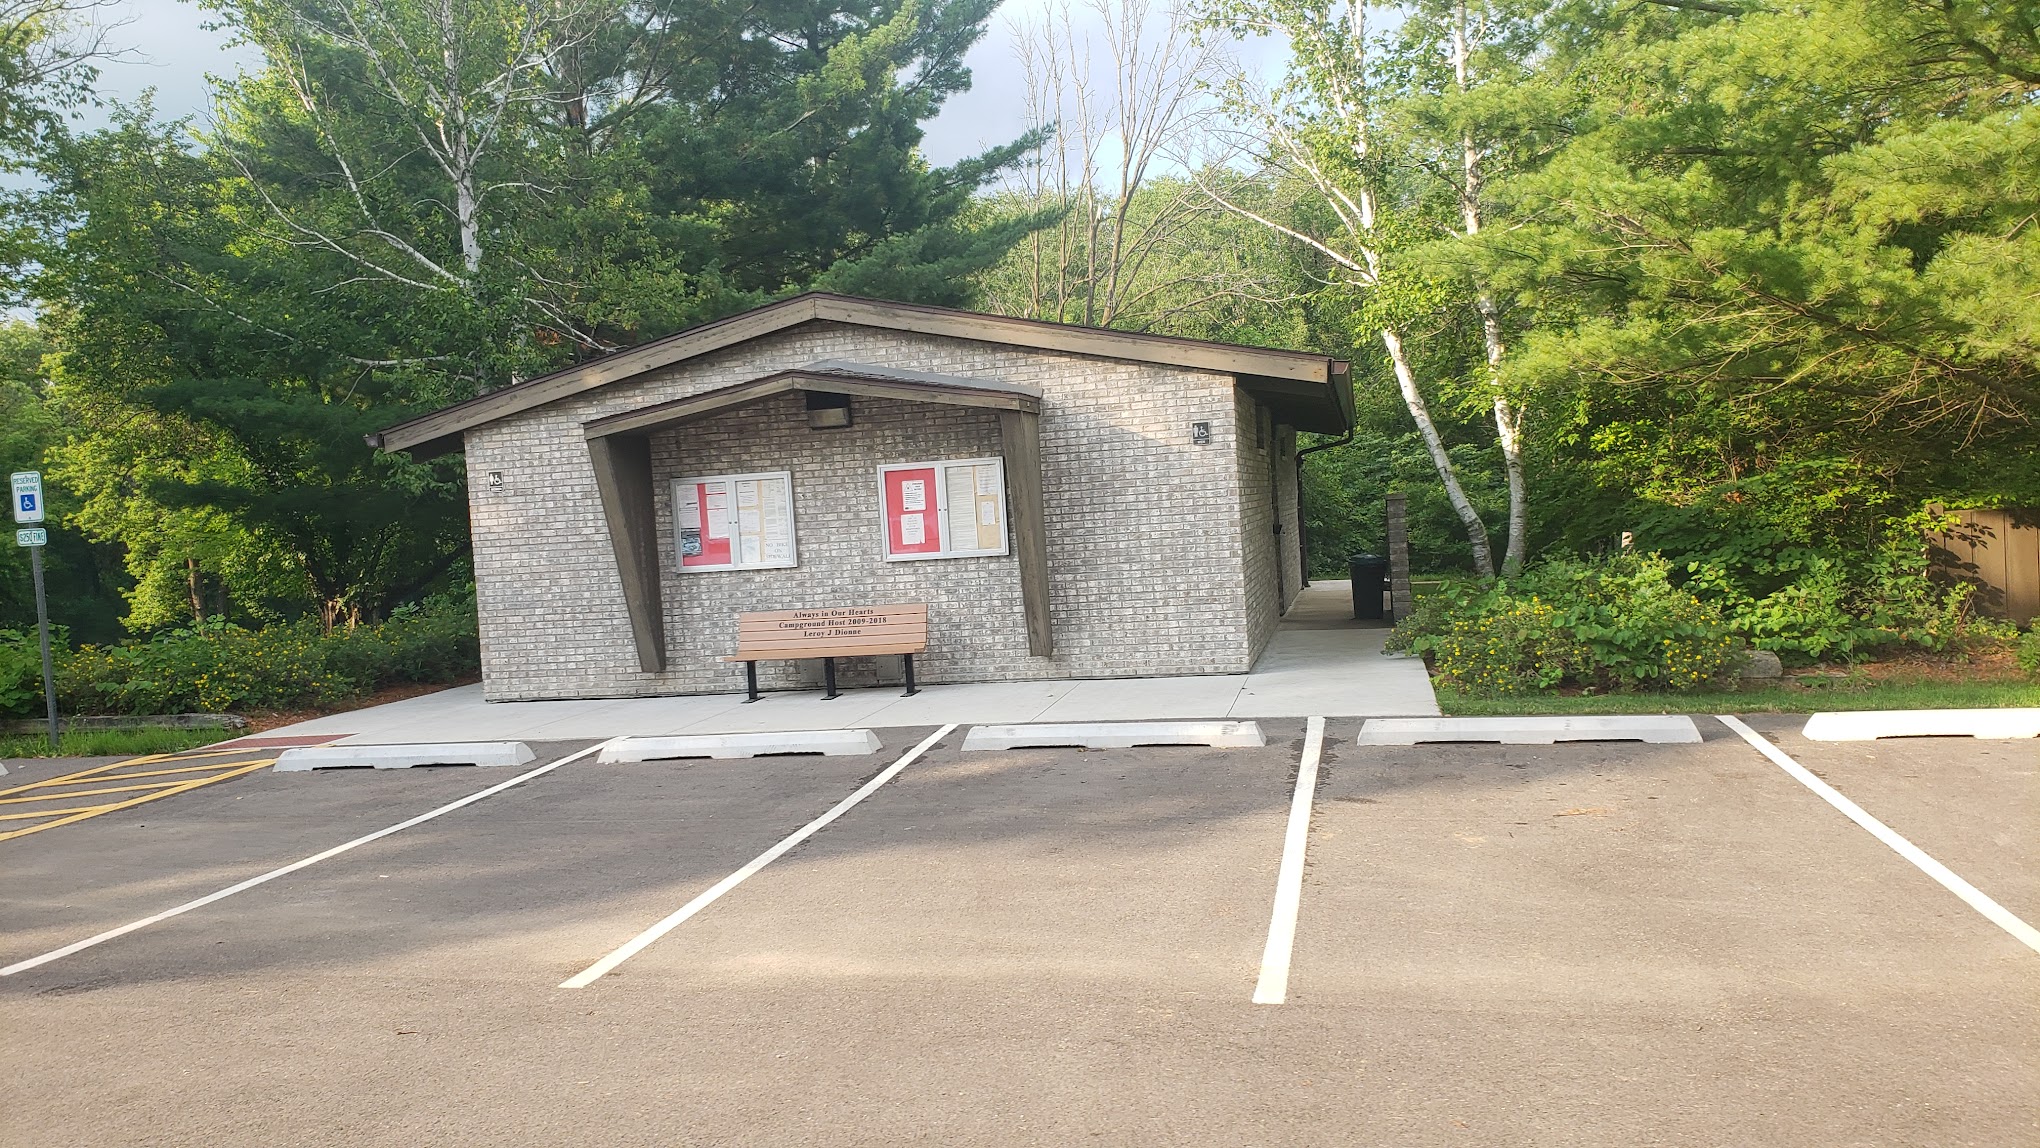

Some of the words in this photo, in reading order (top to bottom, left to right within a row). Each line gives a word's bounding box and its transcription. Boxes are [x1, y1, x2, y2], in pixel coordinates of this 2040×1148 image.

[16, 485, 38, 493] PARKING
[19, 532, 33, 542] $250
[33, 531, 44, 541] FINE
[793, 611, 819, 619] Always
[831, 609, 846, 617] Our
[848, 608, 874, 616] Hearts
[778, 620, 826, 630] Campground
[828, 618, 846, 626] Host
[848, 617, 887, 625] 2009-2018
[803, 630, 825, 638] Leroy
[834, 628, 862, 636] Dionne
